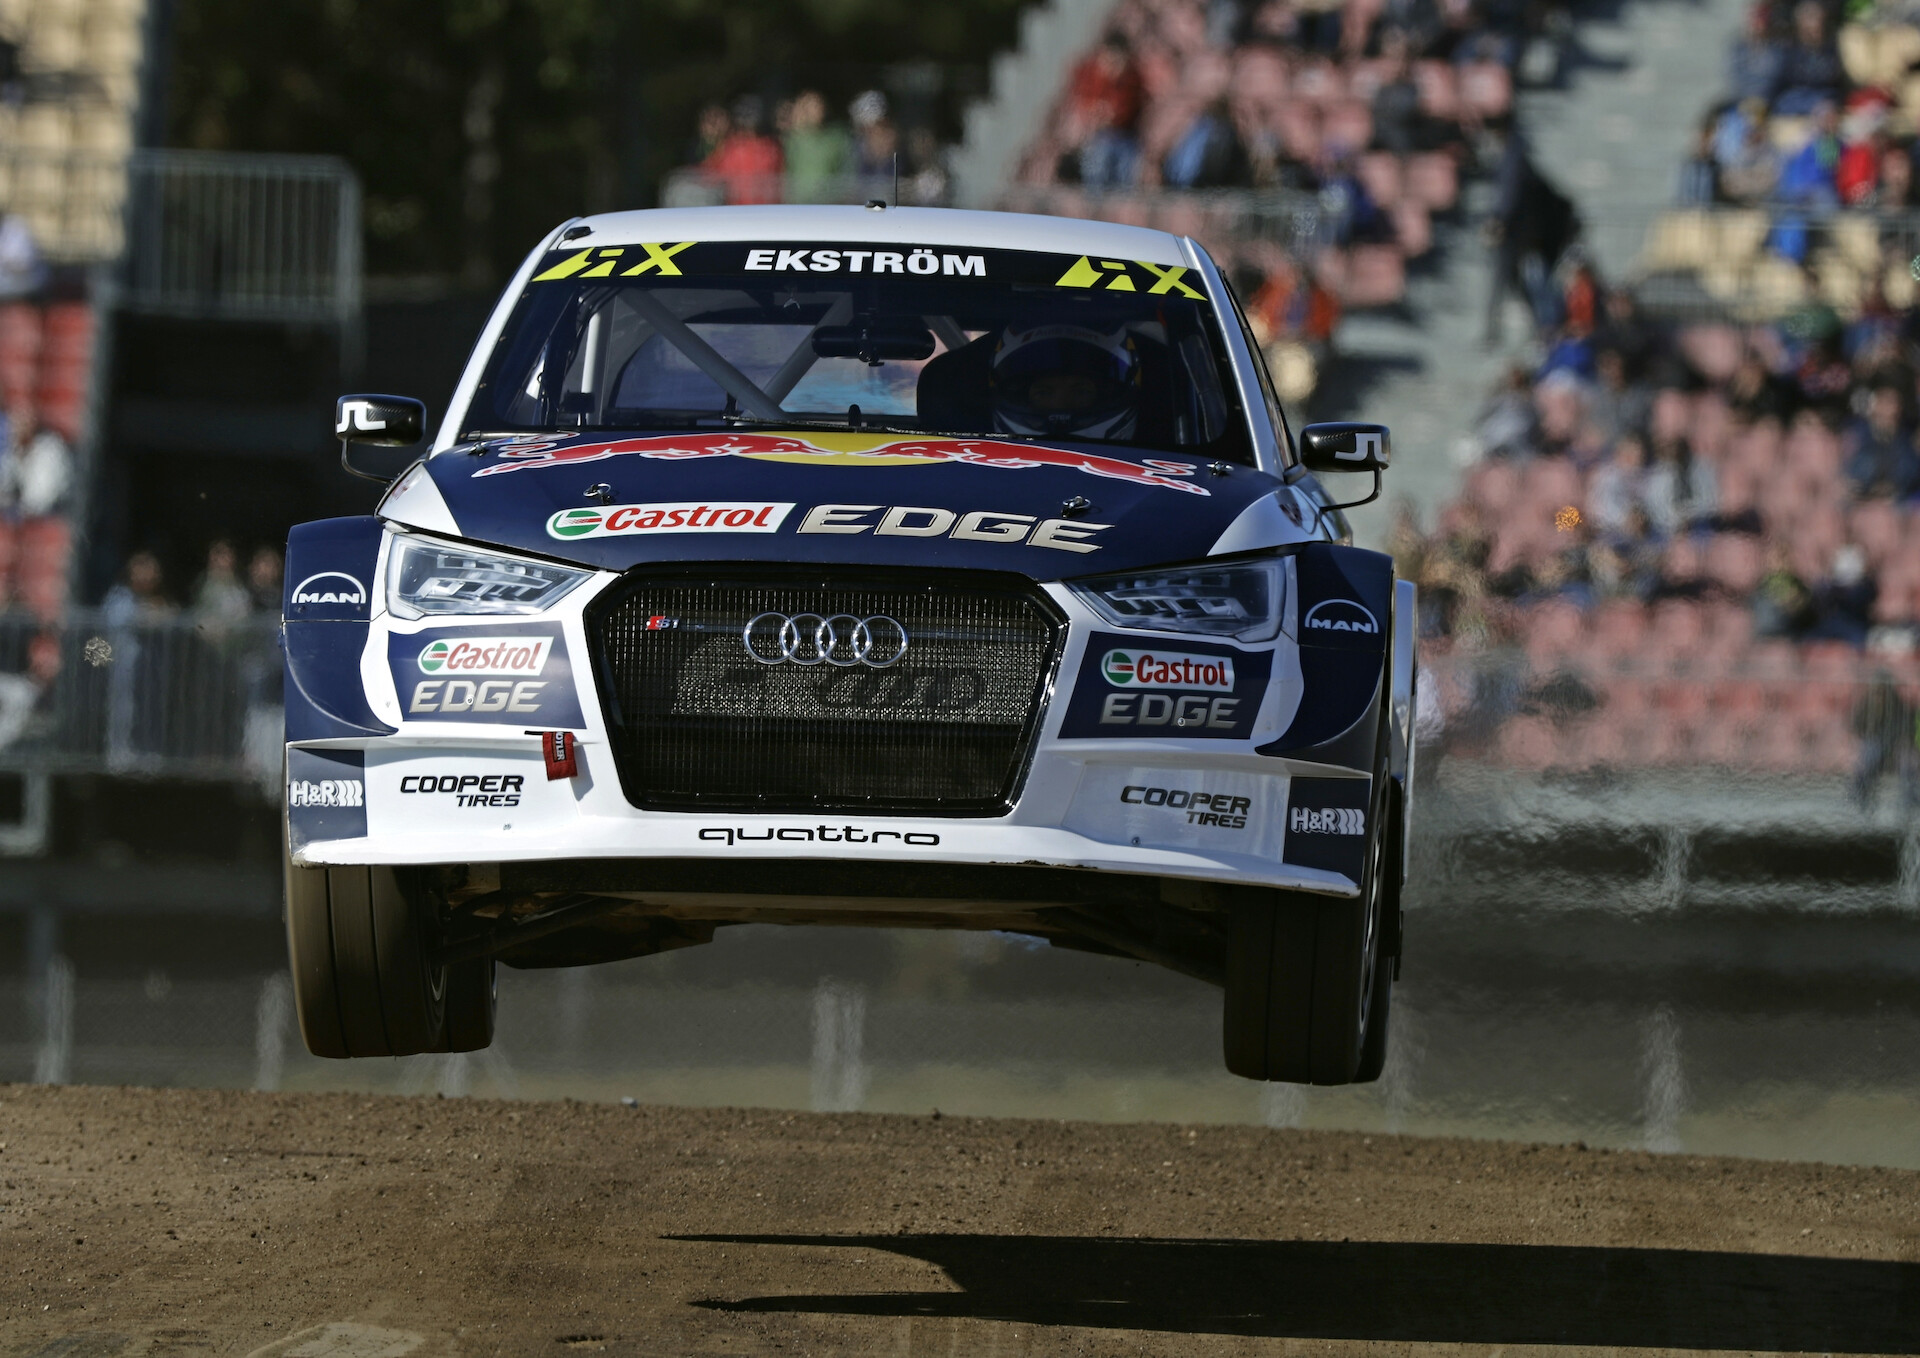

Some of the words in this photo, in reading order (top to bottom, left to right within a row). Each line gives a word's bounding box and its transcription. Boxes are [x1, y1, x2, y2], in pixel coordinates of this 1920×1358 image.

[744, 248, 986, 277] EKSTRÖM
[605, 506, 775, 532] Castrol
[796, 504, 1115, 554] EDGE
[299, 592, 361, 604] MAN
[1311, 619, 1371, 633] MAN
[447, 641, 542, 670] Castrol
[1136, 655, 1228, 686] Castrol
[408, 680, 548, 713] EDGE
[1100, 693, 1242, 729] EDGE
[289, 780, 342, 807] H&R
[400, 775, 524, 793] COOPER
[456, 794, 520, 808] TIRES
[1120, 786, 1251, 815] COOPER
[1186, 811, 1247, 829] TIRES
[1291, 807, 1341, 835] H&R
[698, 825, 940, 846] quattro
